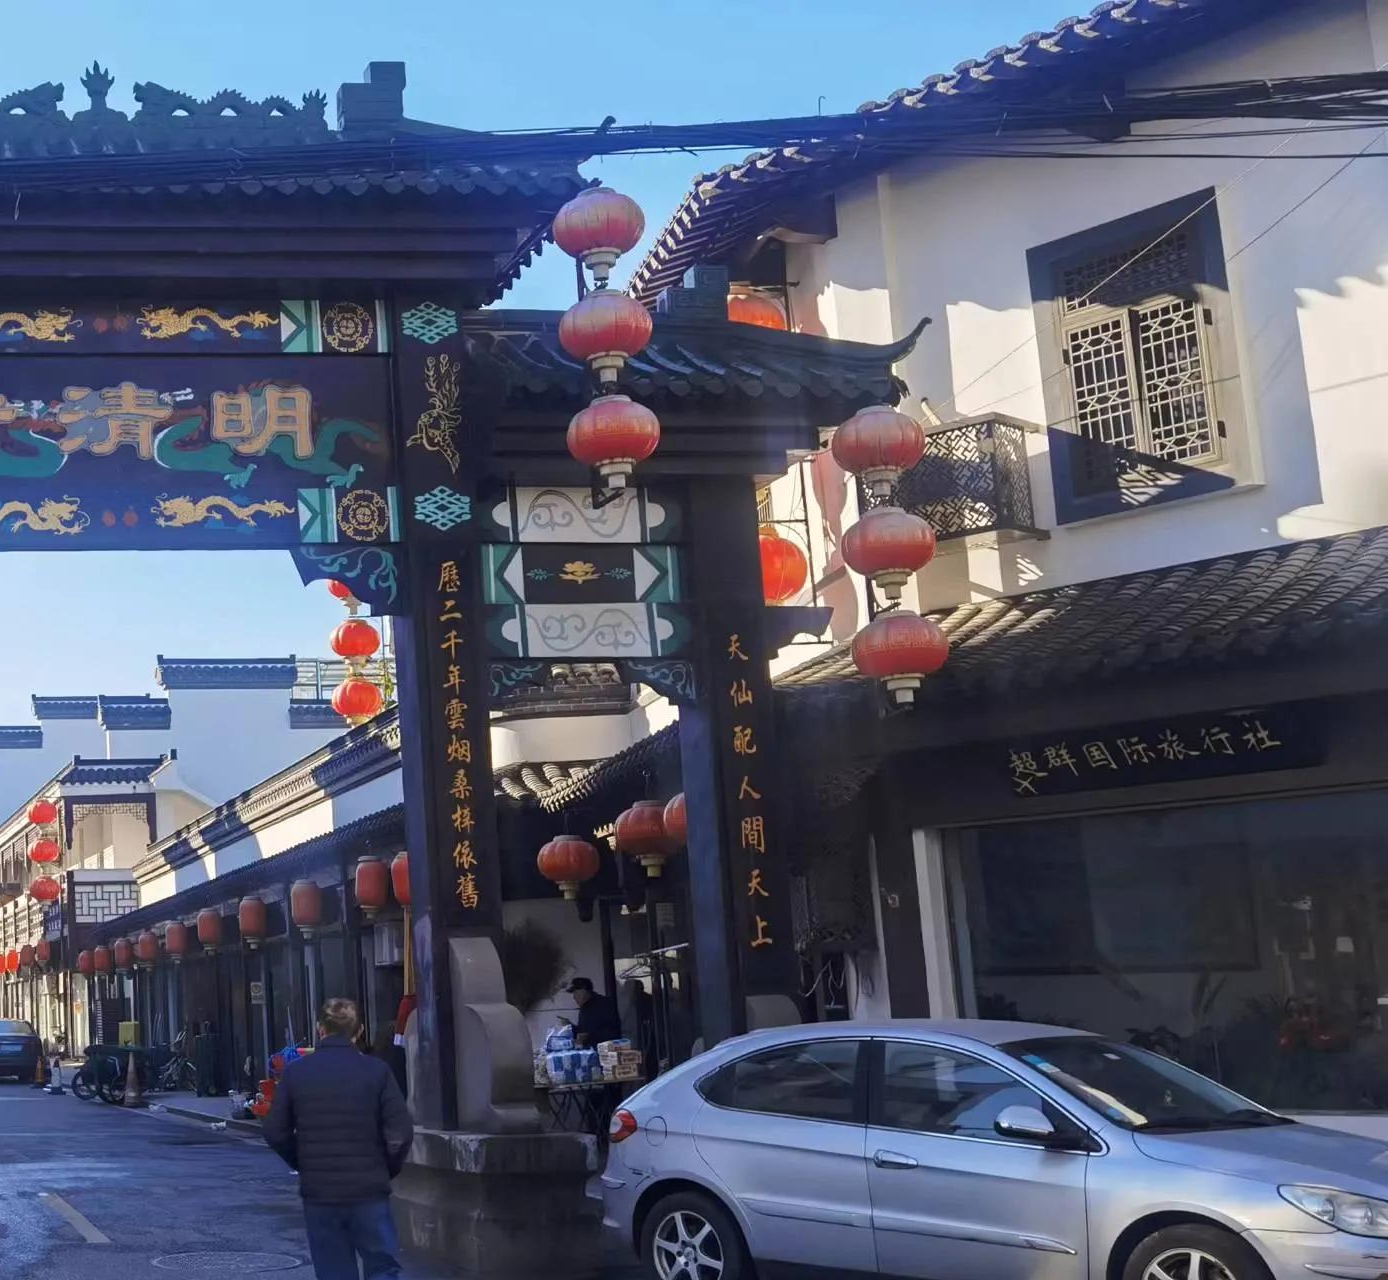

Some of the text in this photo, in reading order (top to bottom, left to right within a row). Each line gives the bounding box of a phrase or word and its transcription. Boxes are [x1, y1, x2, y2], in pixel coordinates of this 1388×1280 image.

[1009, 720, 1282, 778] 超群国际旅行社
